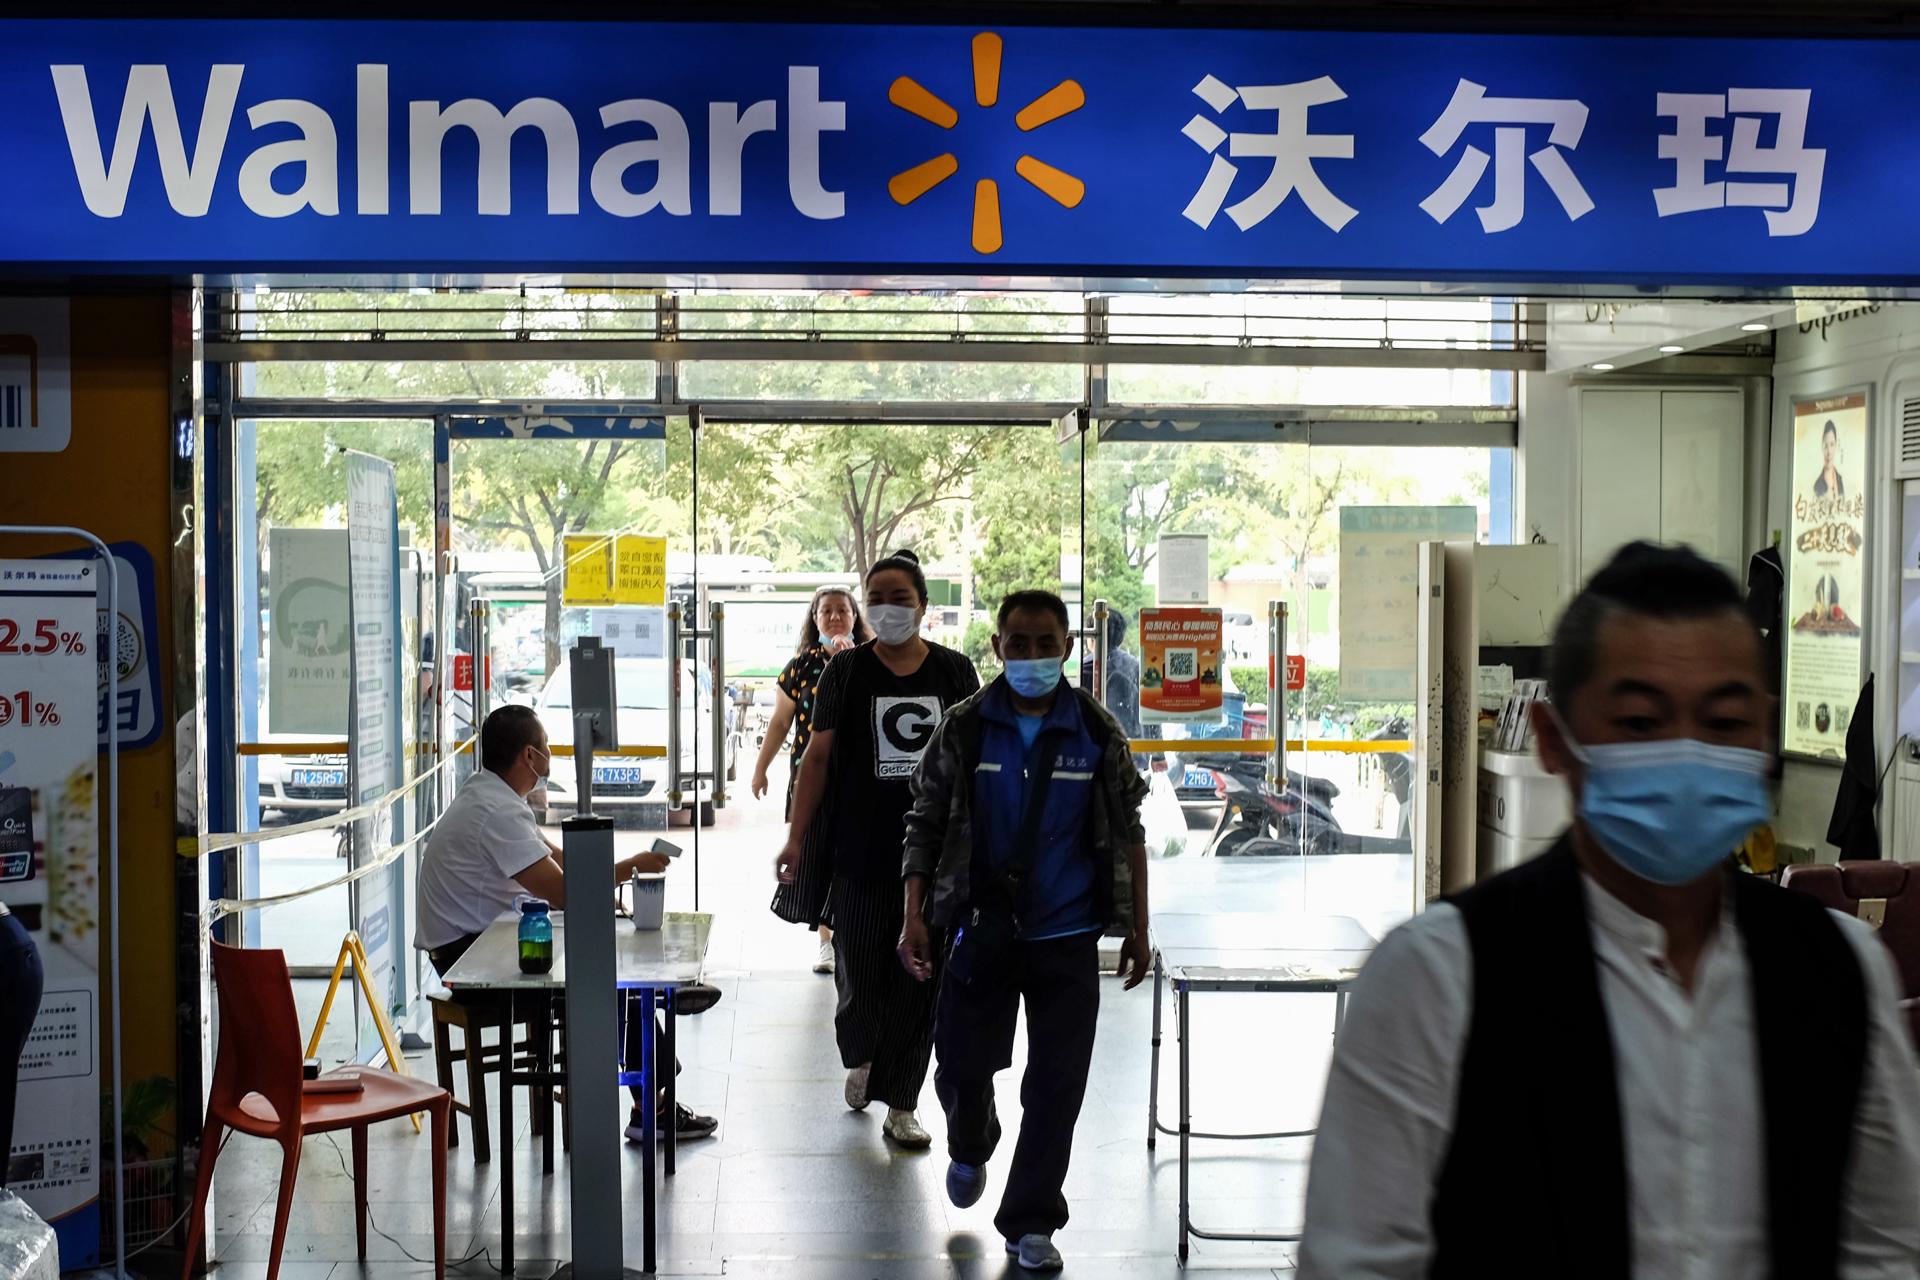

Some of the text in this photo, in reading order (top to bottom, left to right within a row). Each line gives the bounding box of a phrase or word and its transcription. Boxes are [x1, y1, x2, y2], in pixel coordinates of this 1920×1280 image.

[50, 63, 846, 220] Walmart
[1181, 73, 1827, 237] 沃尔玛
[882, 701, 936, 752] G
